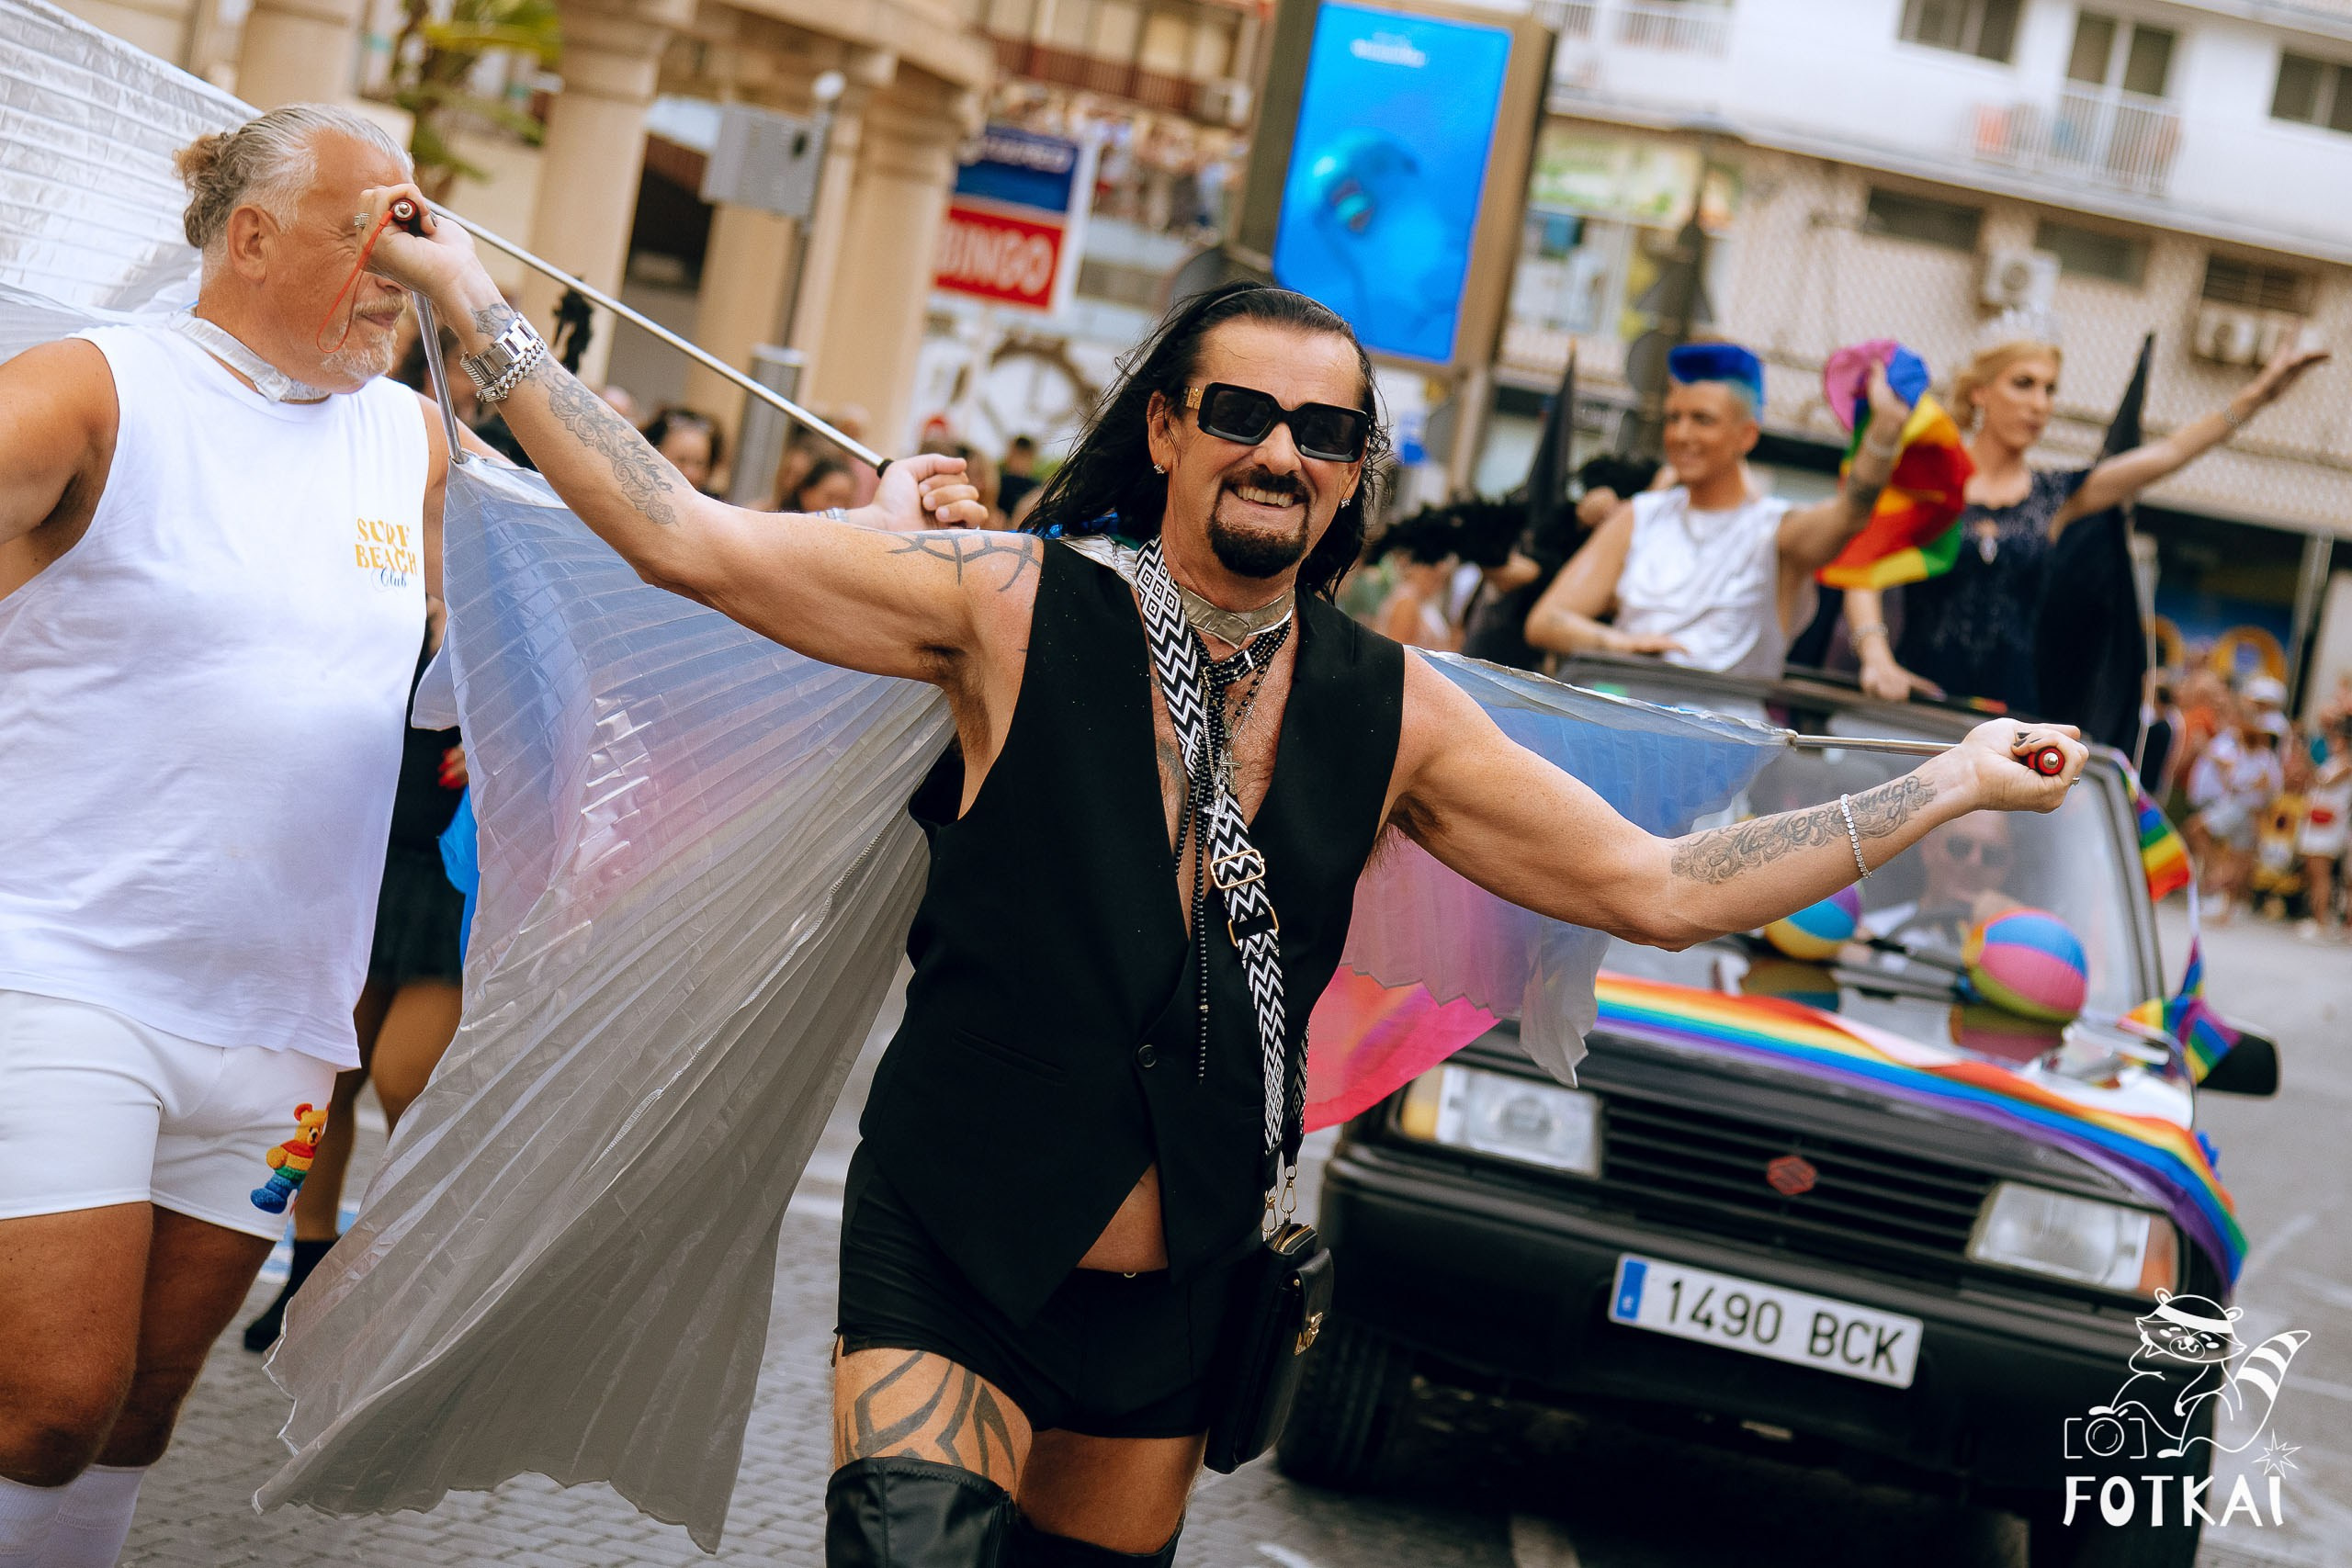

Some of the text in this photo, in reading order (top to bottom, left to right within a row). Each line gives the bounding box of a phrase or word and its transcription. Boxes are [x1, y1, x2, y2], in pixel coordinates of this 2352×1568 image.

[356, 517, 410, 547] SURF
[355, 543, 417, 575] BEACH
[1669, 1280, 1904, 1376] 1490 BCK
